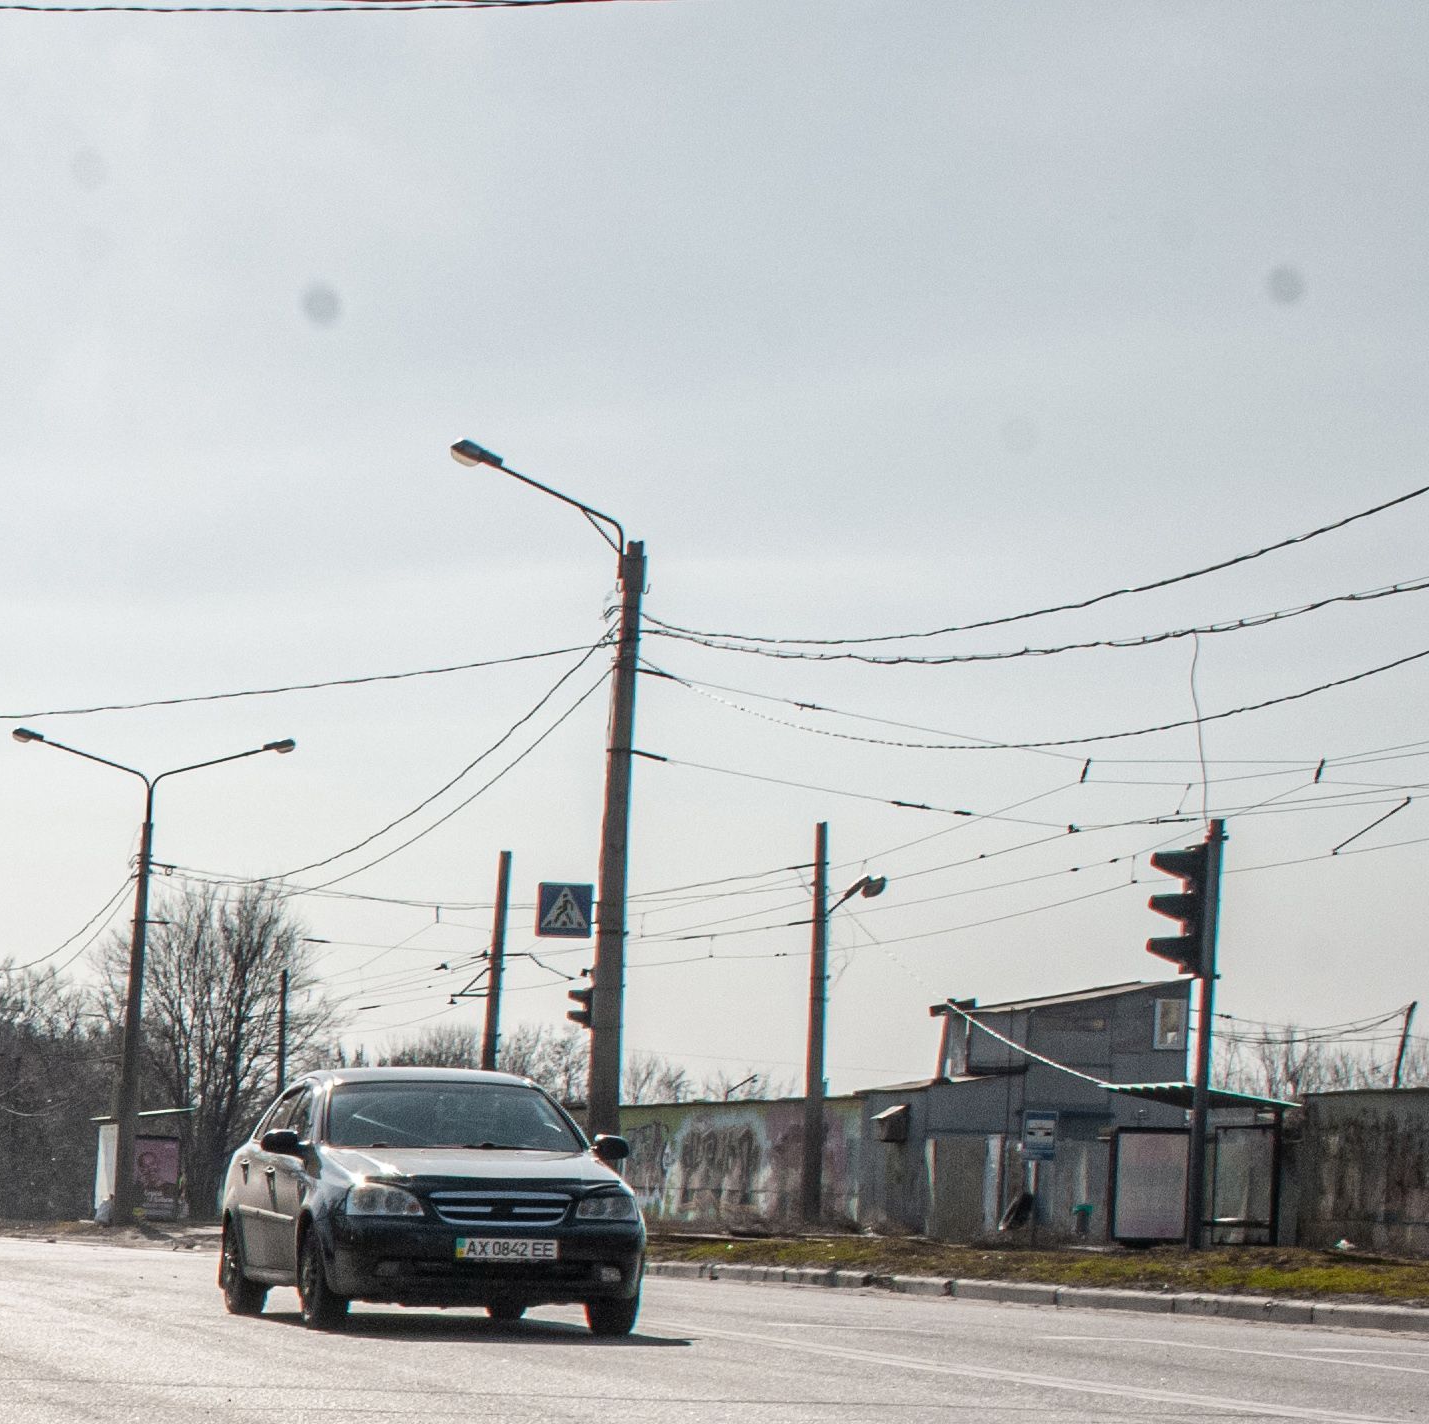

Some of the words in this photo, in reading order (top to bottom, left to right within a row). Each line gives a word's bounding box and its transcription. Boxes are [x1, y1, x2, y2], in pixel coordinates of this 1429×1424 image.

[466, 1240, 490, 1256] AX
[492, 1241, 529, 1256] 0842
[532, 1242, 554, 1257] EE
